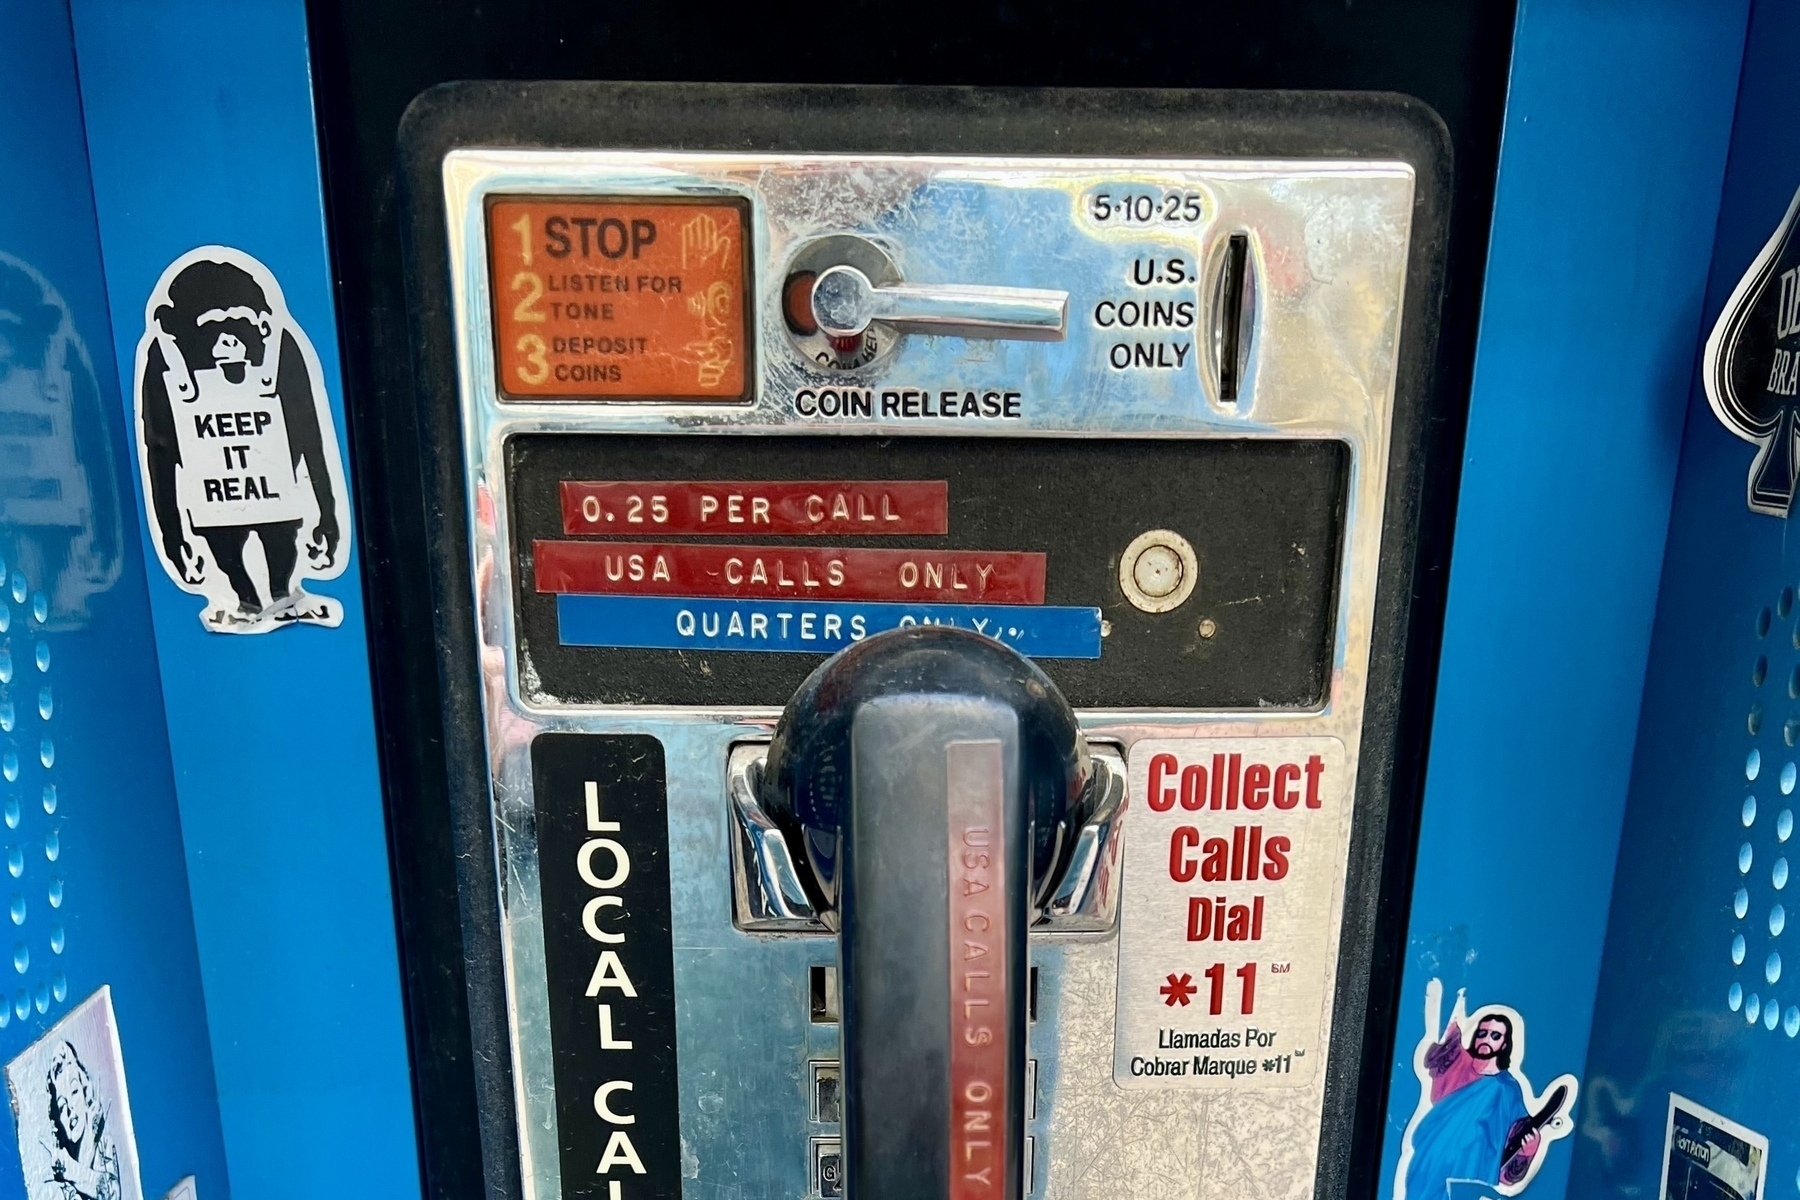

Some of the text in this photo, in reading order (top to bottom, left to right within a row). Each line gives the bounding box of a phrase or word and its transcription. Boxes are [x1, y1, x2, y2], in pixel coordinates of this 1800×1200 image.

[512, 215, 657, 266] 1 STOP
[1134, 259, 1196, 285] U.S.
[511, 272, 682, 323] 2 LISTEN FOR
[551, 302, 614, 322] TONE
[1095, 301, 1194, 328] COINS
[516, 333, 647, 385] 3 DEPOSIT
[1110, 343, 1190, 369] ONLY
[555, 365, 622, 382] COINS
[796, 390, 1021, 419] COIN RELEASE
[194, 411, 271, 439] KEEP
[223, 446, 250, 470] IT
[204, 477, 280, 502] REAL
[582, 494, 901, 523] 0.25 PER CALL
[605, 555, 993, 590] USA CALLS ONLY
[676, 610, 866, 641] QUARTERS
[1147, 752, 1326, 813] Collect
[1169, 825, 1291, 883] Calls
[575, 781, 637, 1050] LOCAL
[1187, 896, 1264, 942] Dial
[962, 827, 993, 1186] USA CALLS ONLY
[1158, 1027, 1277, 1049] Llamadas Por
[1130, 1056, 1190, 1077] Cobrar
[1193, 1054, 1257, 1079] Marque
